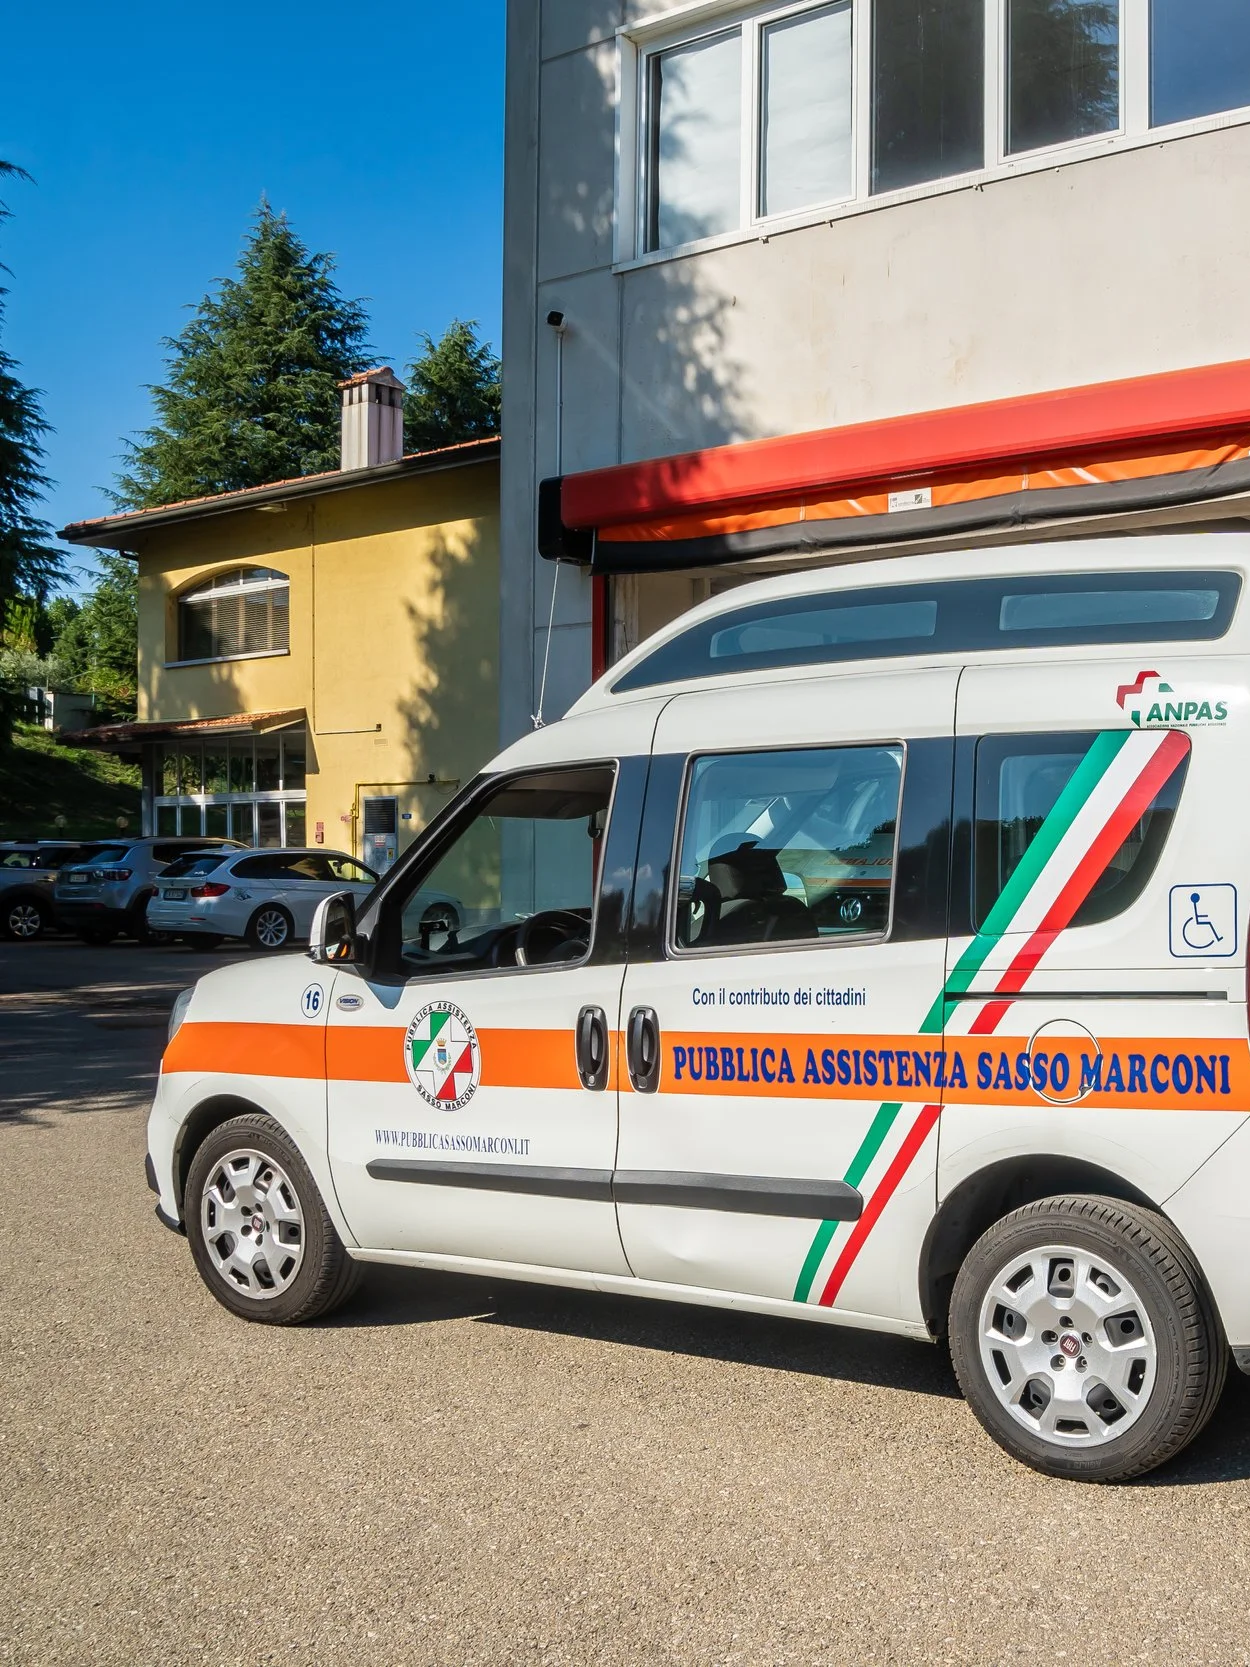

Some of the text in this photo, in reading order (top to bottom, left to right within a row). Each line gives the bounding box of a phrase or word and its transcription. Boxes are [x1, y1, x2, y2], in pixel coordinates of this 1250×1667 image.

[1146, 701, 1228, 722] ANPAS
[306, 990, 320, 1011] 16
[692, 987, 866, 1006] Con il contributo dei cittadini
[406, 1003, 477, 1051] PUBBLICA ASSISTENZA
[672, 1046, 1231, 1095] PUBBLICA ASSISTENZA SASSO MARCONI
[416, 1083, 476, 1110] SASSO MARCONI
[375, 1129, 530, 1156] WWW.PUBBLICASASSOMARCONI.IT
